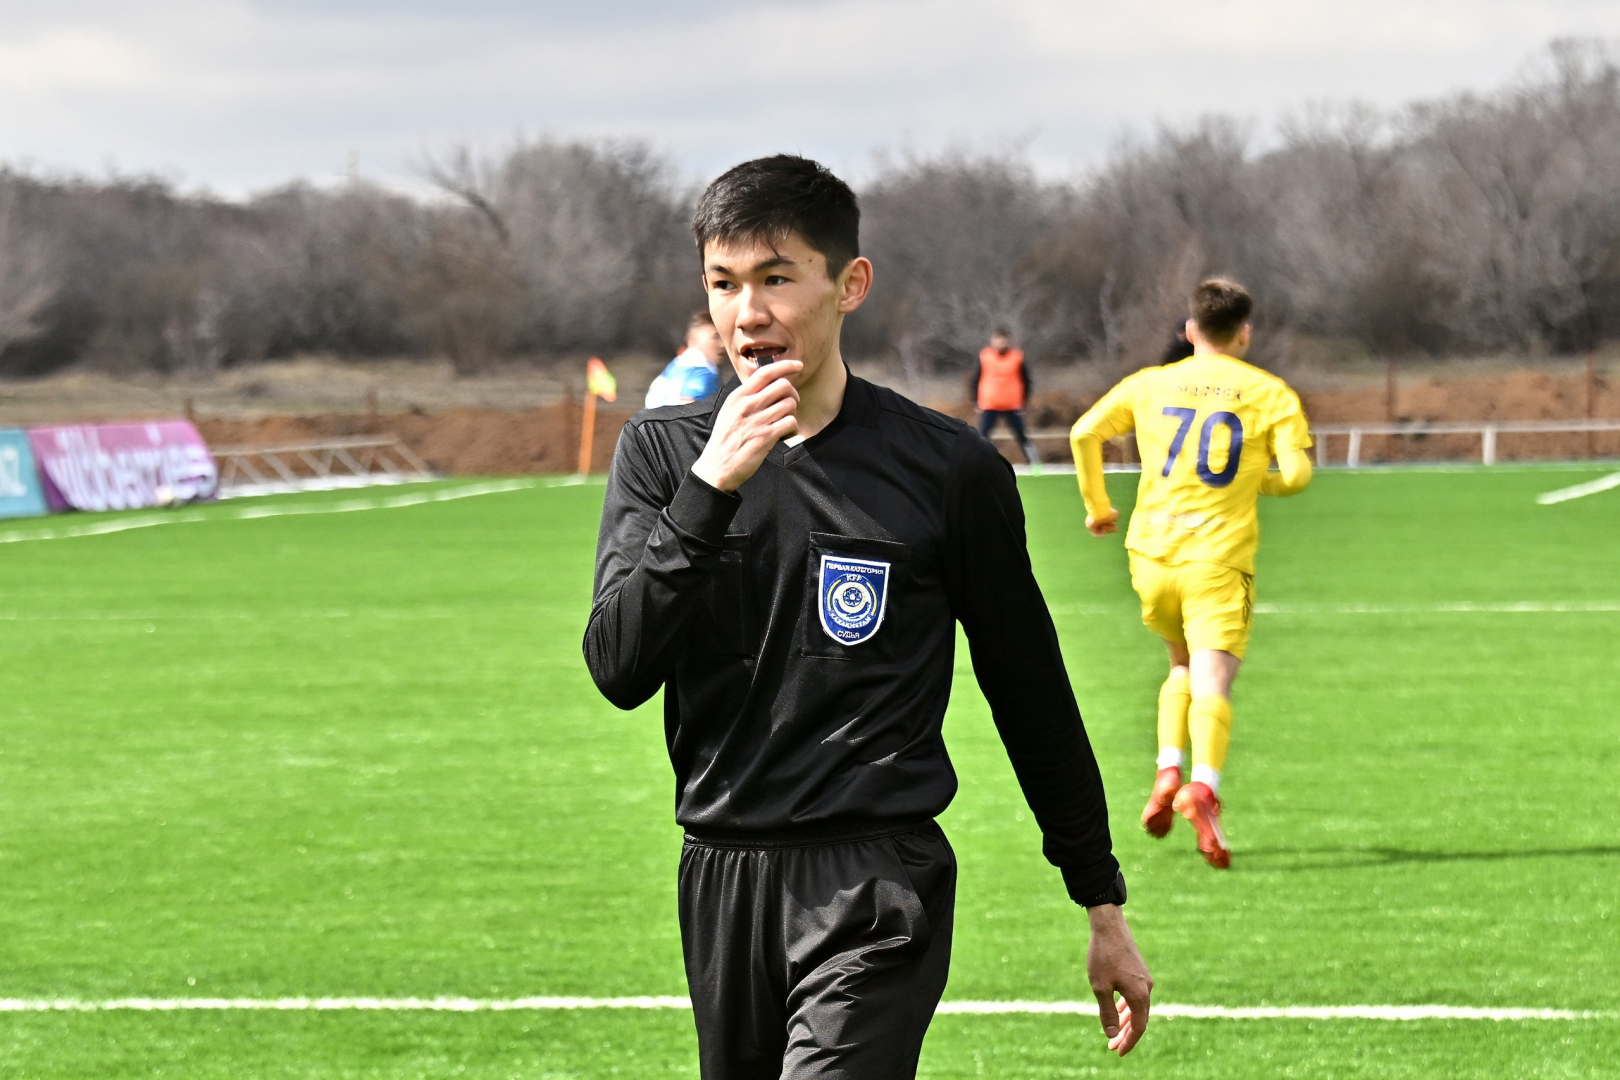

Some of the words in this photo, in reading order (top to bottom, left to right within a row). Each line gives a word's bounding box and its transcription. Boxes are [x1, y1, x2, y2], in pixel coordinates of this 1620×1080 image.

[1162, 407, 1243, 488] 70
[851, 566, 884, 575] КАТЕГОРИЯ
[846, 574, 862, 582] KFF
[837, 630, 860, 639] СУДЬЯ
